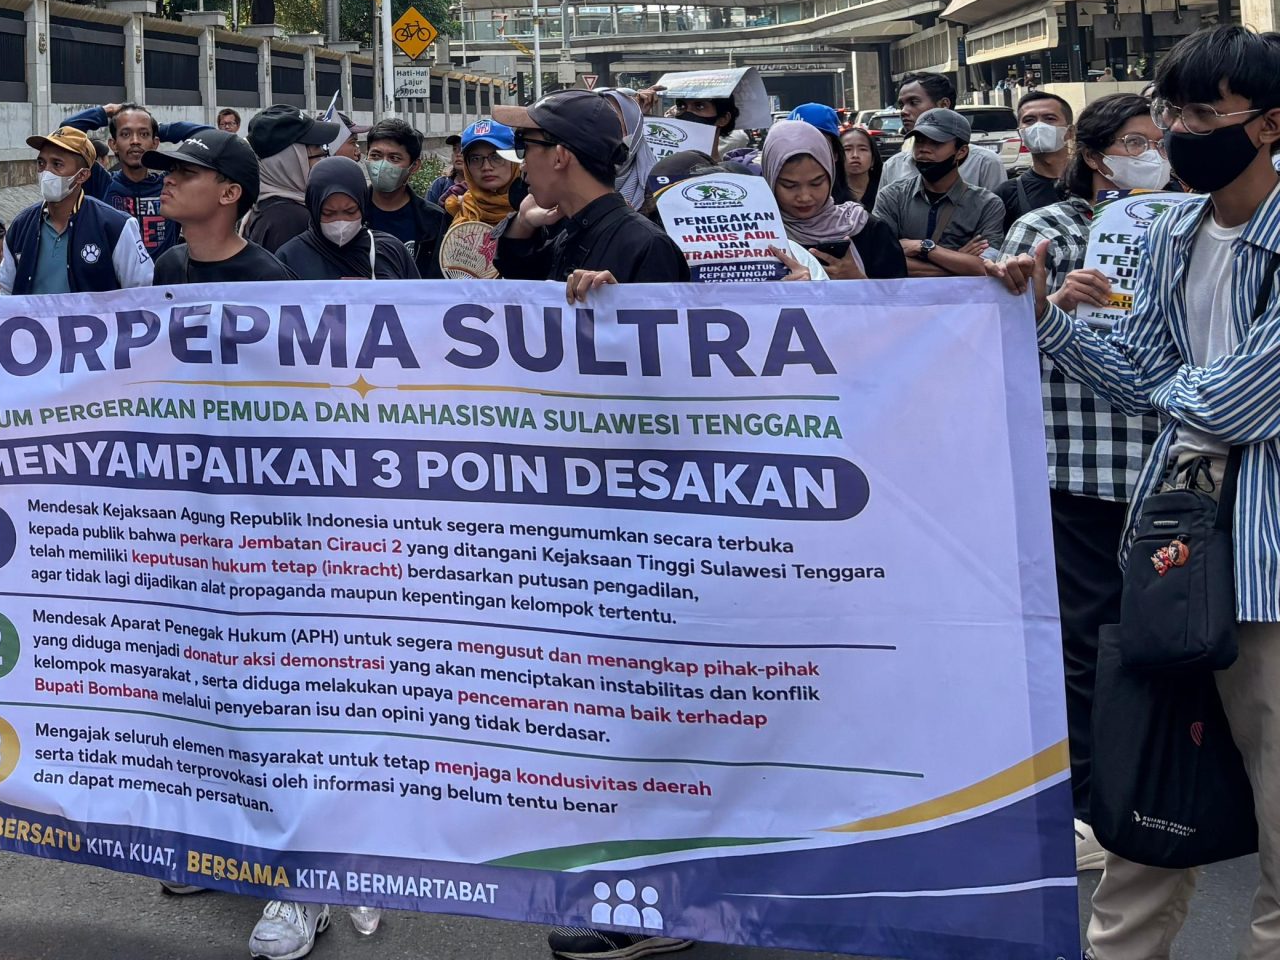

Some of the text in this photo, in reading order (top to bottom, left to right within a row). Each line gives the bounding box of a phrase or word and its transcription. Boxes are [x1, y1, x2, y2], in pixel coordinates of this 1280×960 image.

[657, 176, 669, 184] 9
[674, 212, 775, 226] PENEGAKAN
[682, 231, 780, 242] HARUS ADIL
[696, 222, 759, 233] HUKUM
[719, 241, 750, 249] DAN
[699, 271, 776, 279] KEPENTINGAN
[442, 304, 837, 377] SULTRA
[40, 397, 196, 424] PERGERAKAN
[203, 399, 308, 422] PEMUDA
[315, 402, 370, 423] DAN
[378, 402, 537, 430] MAHASISWA
[543, 409, 679, 435] SULAWESI
[687, 413, 843, 439] TENGGARA
[371, 449, 401, 488] 3
[417, 450, 548, 494] POIN
[563, 457, 837, 509] DESAKAN
[28, 499, 794, 553] Mendesak Kejaksaan Agung Republik Indonesia untuk segera mengumumkan secara terbuka
[29, 521, 885, 582] kepada publik bahwa perkara Jembatan Cirauci 2 yang ditangani Kejaksaan Tinggi Sulawesi Tenggara
[29, 544, 699, 602] telah memiliki keputusan hukum tetap (inkracht) berdasarkan putusan pengadilan,
[33, 609, 820, 680] Mendesak Aparat Penegak Hukum (APH) untuk segera mengusut dan menangkap pihak-pihak
[33, 634, 820, 701] yang diduga menjadi donatur aksi demonstrasi yang akan menciptakan instabilitas dan konflik
[34, 654, 767, 729] kelompok masyarakat serta diduga melakukan upaya pencemaran nama baik terhadap
[36, 723, 712, 796] Mengajak seluruh elemen masyarakat untuk tetap menjaga kondusivitas daerah
[34, 769, 273, 813] dan dapat memecah persatuan.
[87, 837, 124, 860] KITA
[129, 843, 177, 871] KUAT,
[186, 850, 290, 888] BERSAMA
[296, 868, 340, 891] KITA
[346, 871, 499, 904] BERMARTABAT
